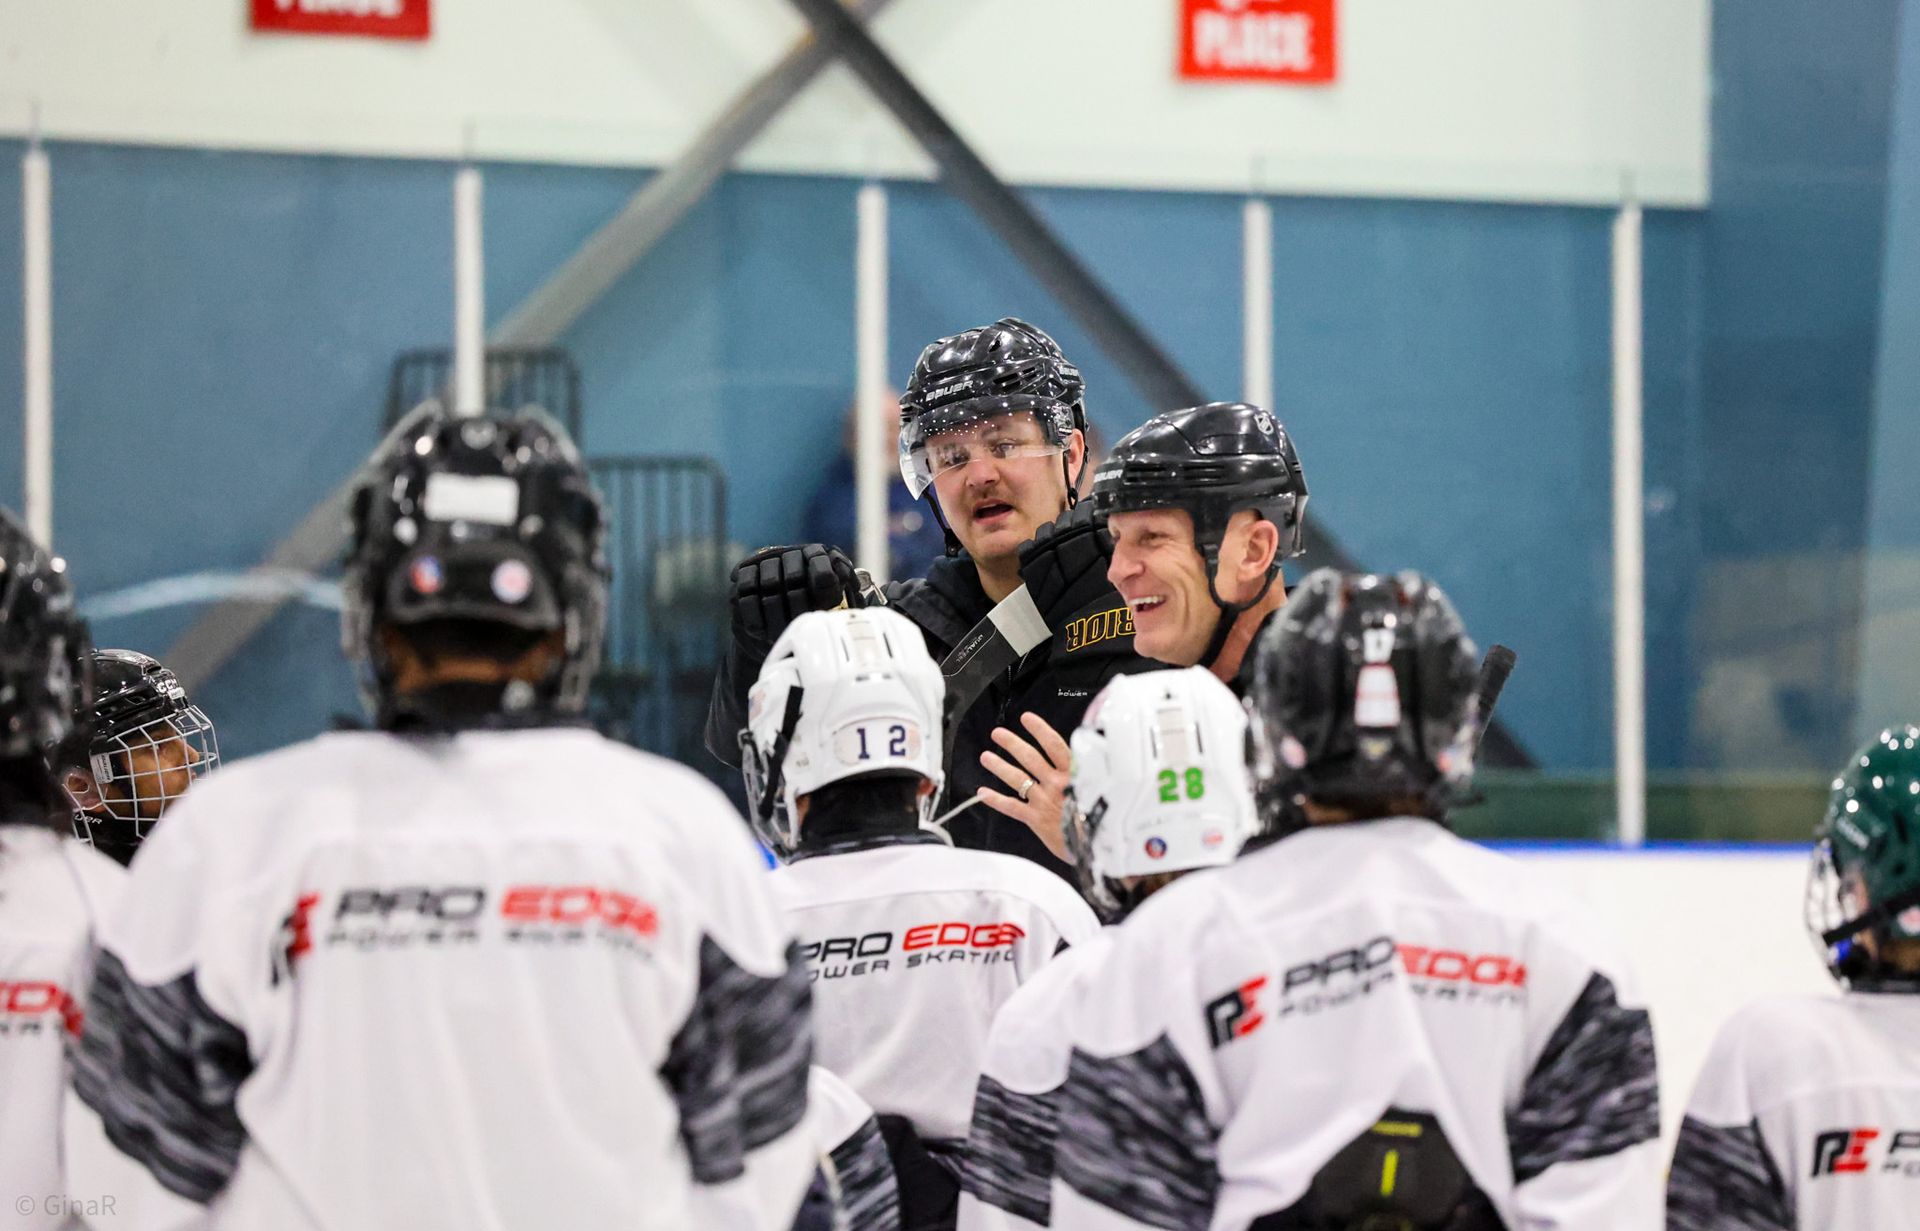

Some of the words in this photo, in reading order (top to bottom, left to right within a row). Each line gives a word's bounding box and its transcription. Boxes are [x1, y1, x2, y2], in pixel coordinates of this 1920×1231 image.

[925, 380, 974, 401] BAUER
[1158, 767, 1205, 803] 28
[335, 886, 487, 920] PRO
[1281, 935, 1396, 996] PRO
